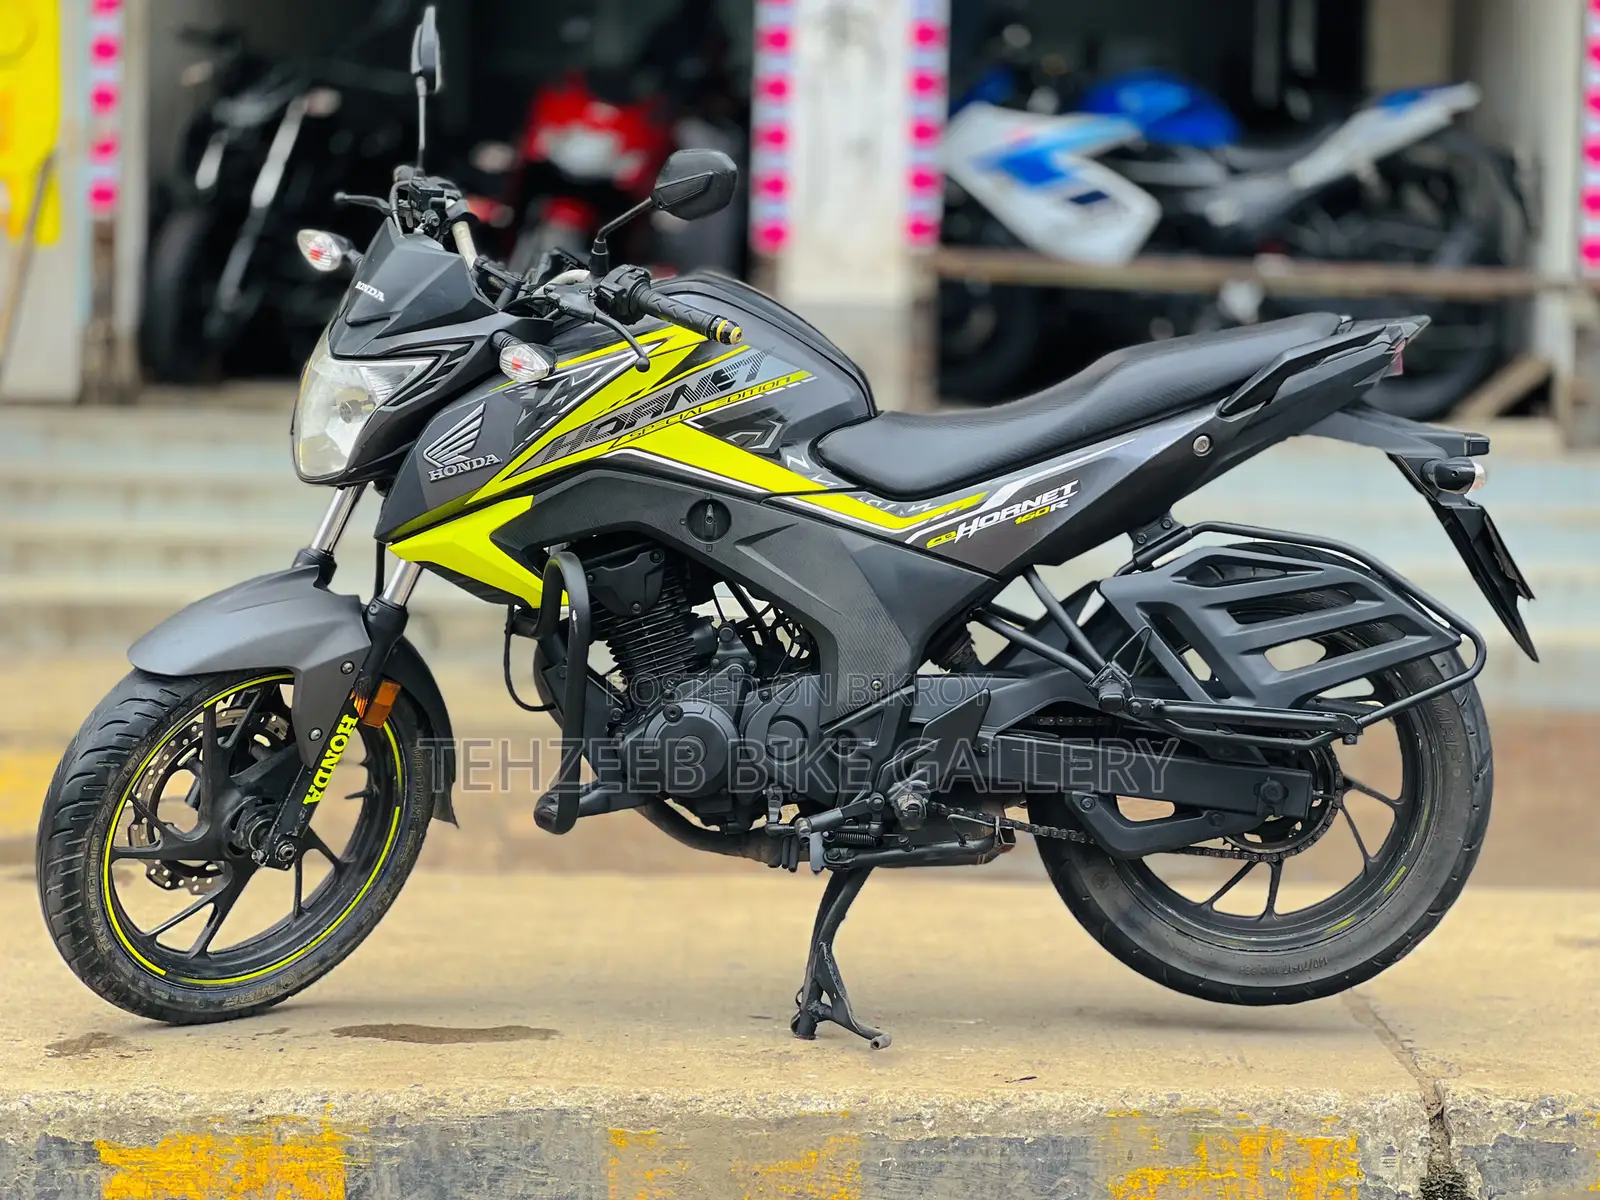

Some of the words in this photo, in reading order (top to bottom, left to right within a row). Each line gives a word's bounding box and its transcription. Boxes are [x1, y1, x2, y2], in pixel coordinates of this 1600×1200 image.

[542, 346, 777, 463] HORNET
[628, 406, 704, 439] SPECIAL
[715, 377, 792, 406] EDITION
[428, 454, 502, 481] HONDA
[954, 479, 1079, 544] HORNET
[1014, 499, 1069, 525] 160R
[303, 714, 359, 805] HONDA
